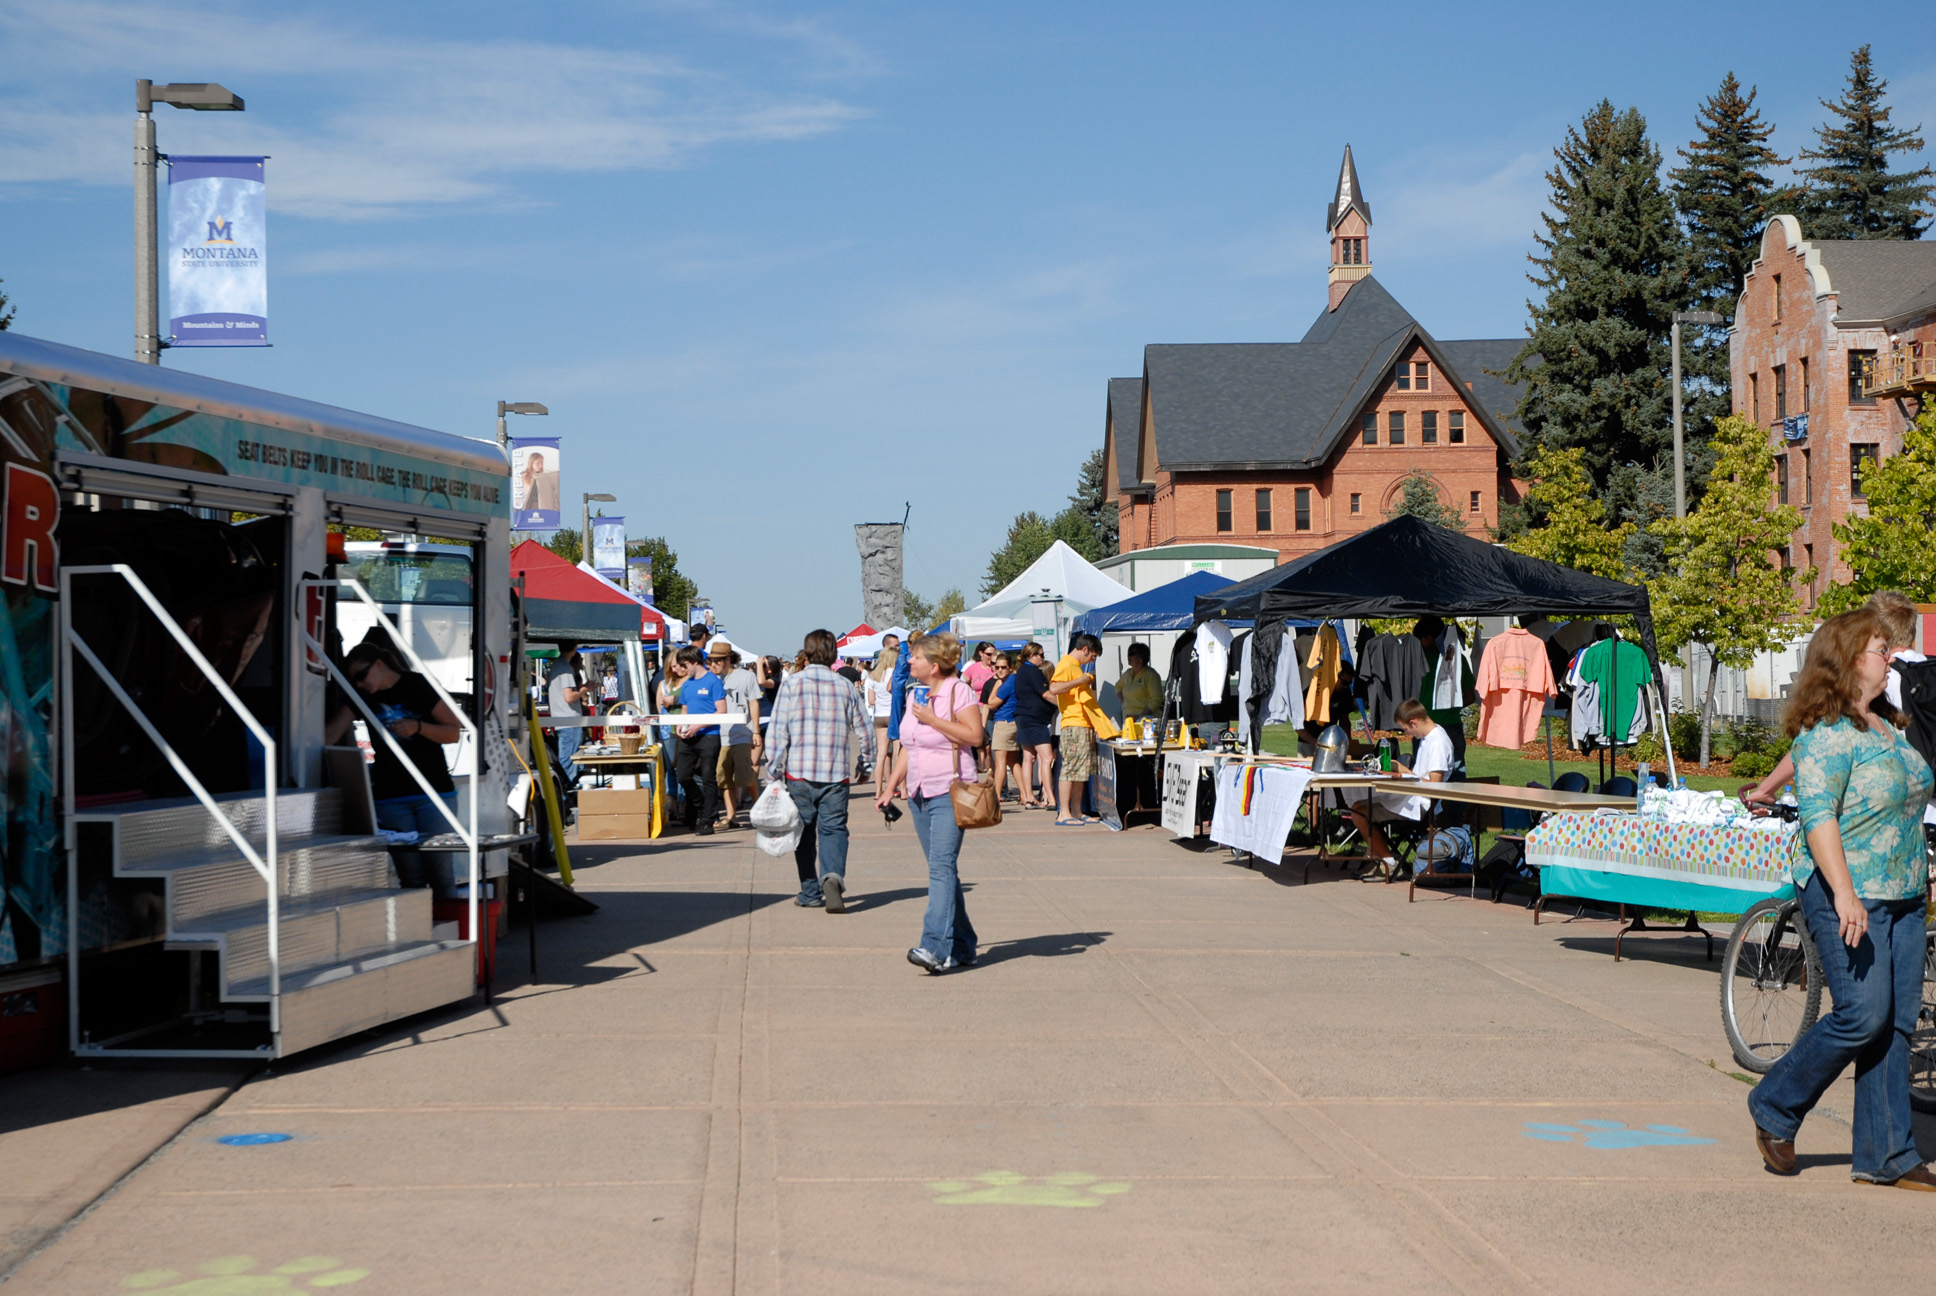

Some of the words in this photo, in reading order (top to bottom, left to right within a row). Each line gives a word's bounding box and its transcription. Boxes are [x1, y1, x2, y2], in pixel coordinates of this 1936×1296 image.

[207, 221, 233, 241] M
[182, 247, 258, 259] MONTANA
[182, 260, 206, 268] STATE
[208, 260, 259, 268] UNIVERSITY
[182, 321, 224, 329] Mountains
[235, 321, 260, 329] Minds
[237, 440, 260, 462] SEAT
[262, 444, 288, 467] BELTS
[290, 449, 312, 471] KEEP
[340, 458, 354, 478] THE
[513, 450, 524, 510] CREATE
